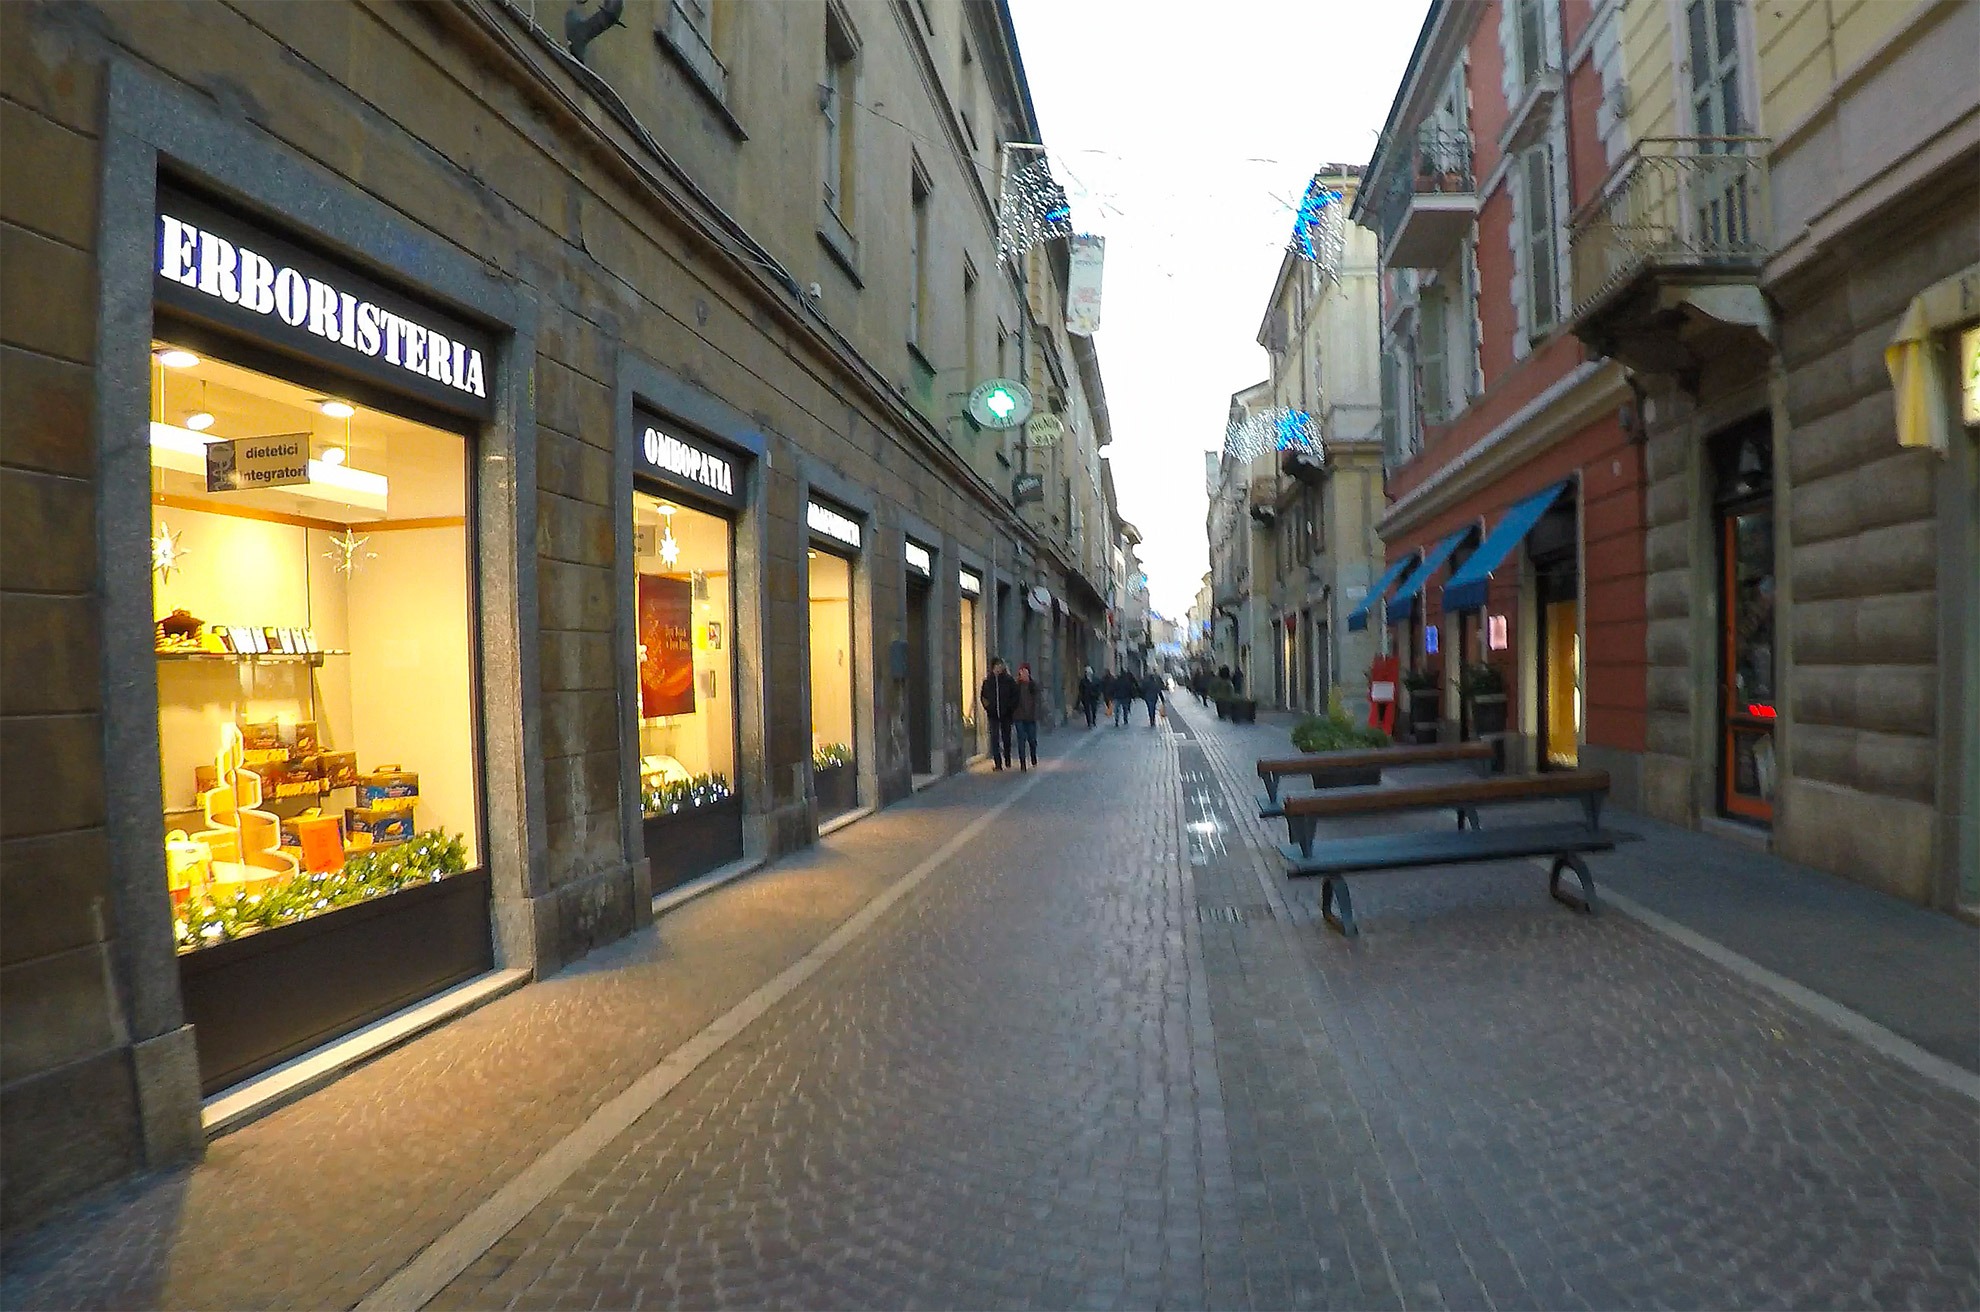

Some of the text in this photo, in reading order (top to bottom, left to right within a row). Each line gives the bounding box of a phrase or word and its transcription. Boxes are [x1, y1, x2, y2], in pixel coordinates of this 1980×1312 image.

[160, 215, 486, 398] ERBORISTERIA
[246, 443, 299, 459] dietetici
[644, 427, 733, 495] OMEOPATIA
